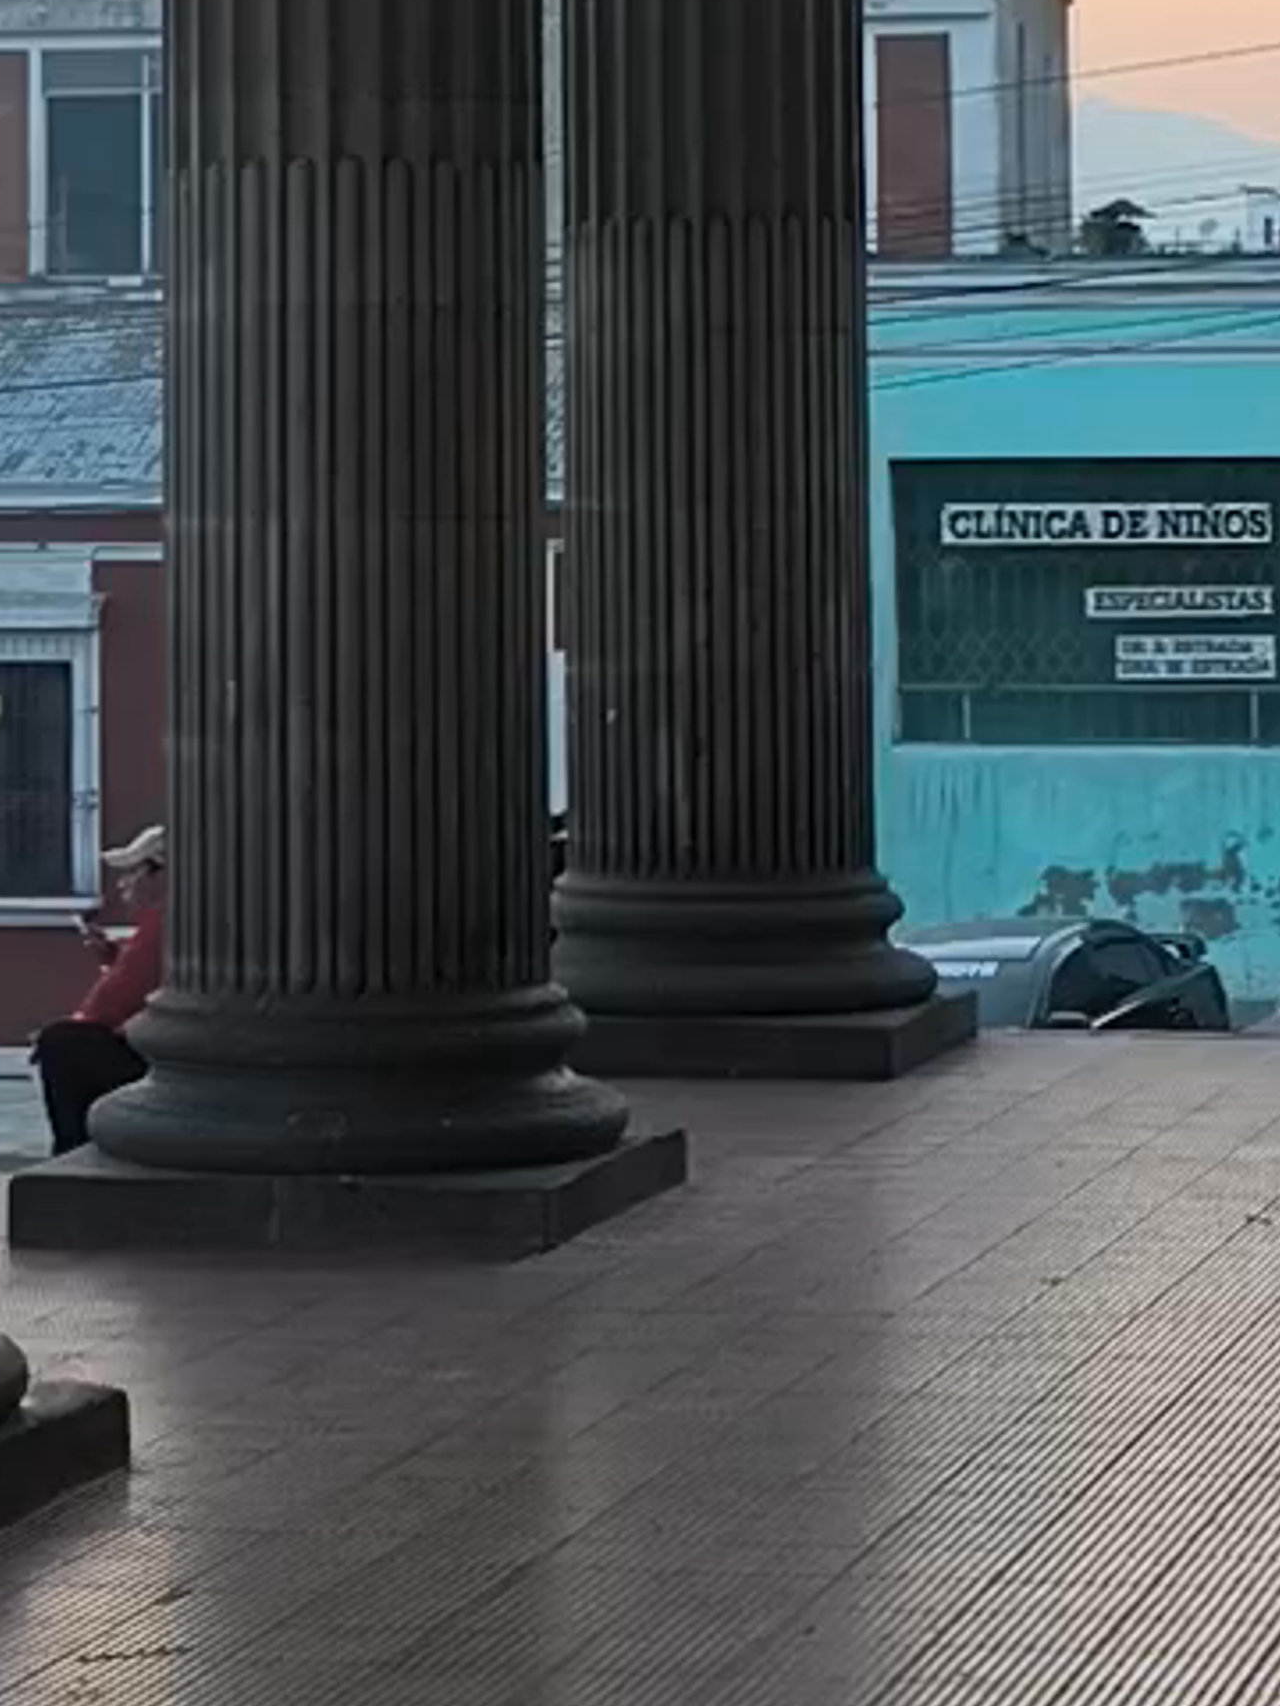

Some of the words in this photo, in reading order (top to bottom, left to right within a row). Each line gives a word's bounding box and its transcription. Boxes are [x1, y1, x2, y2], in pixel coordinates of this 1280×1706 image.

[949, 504, 1093, 539] CLÍNICA
[1100, 510, 1148, 539] DE
[1157, 504, 1267, 539] NIÑOS
[1093, 590, 1266, 611] ESPECIALISTAS
